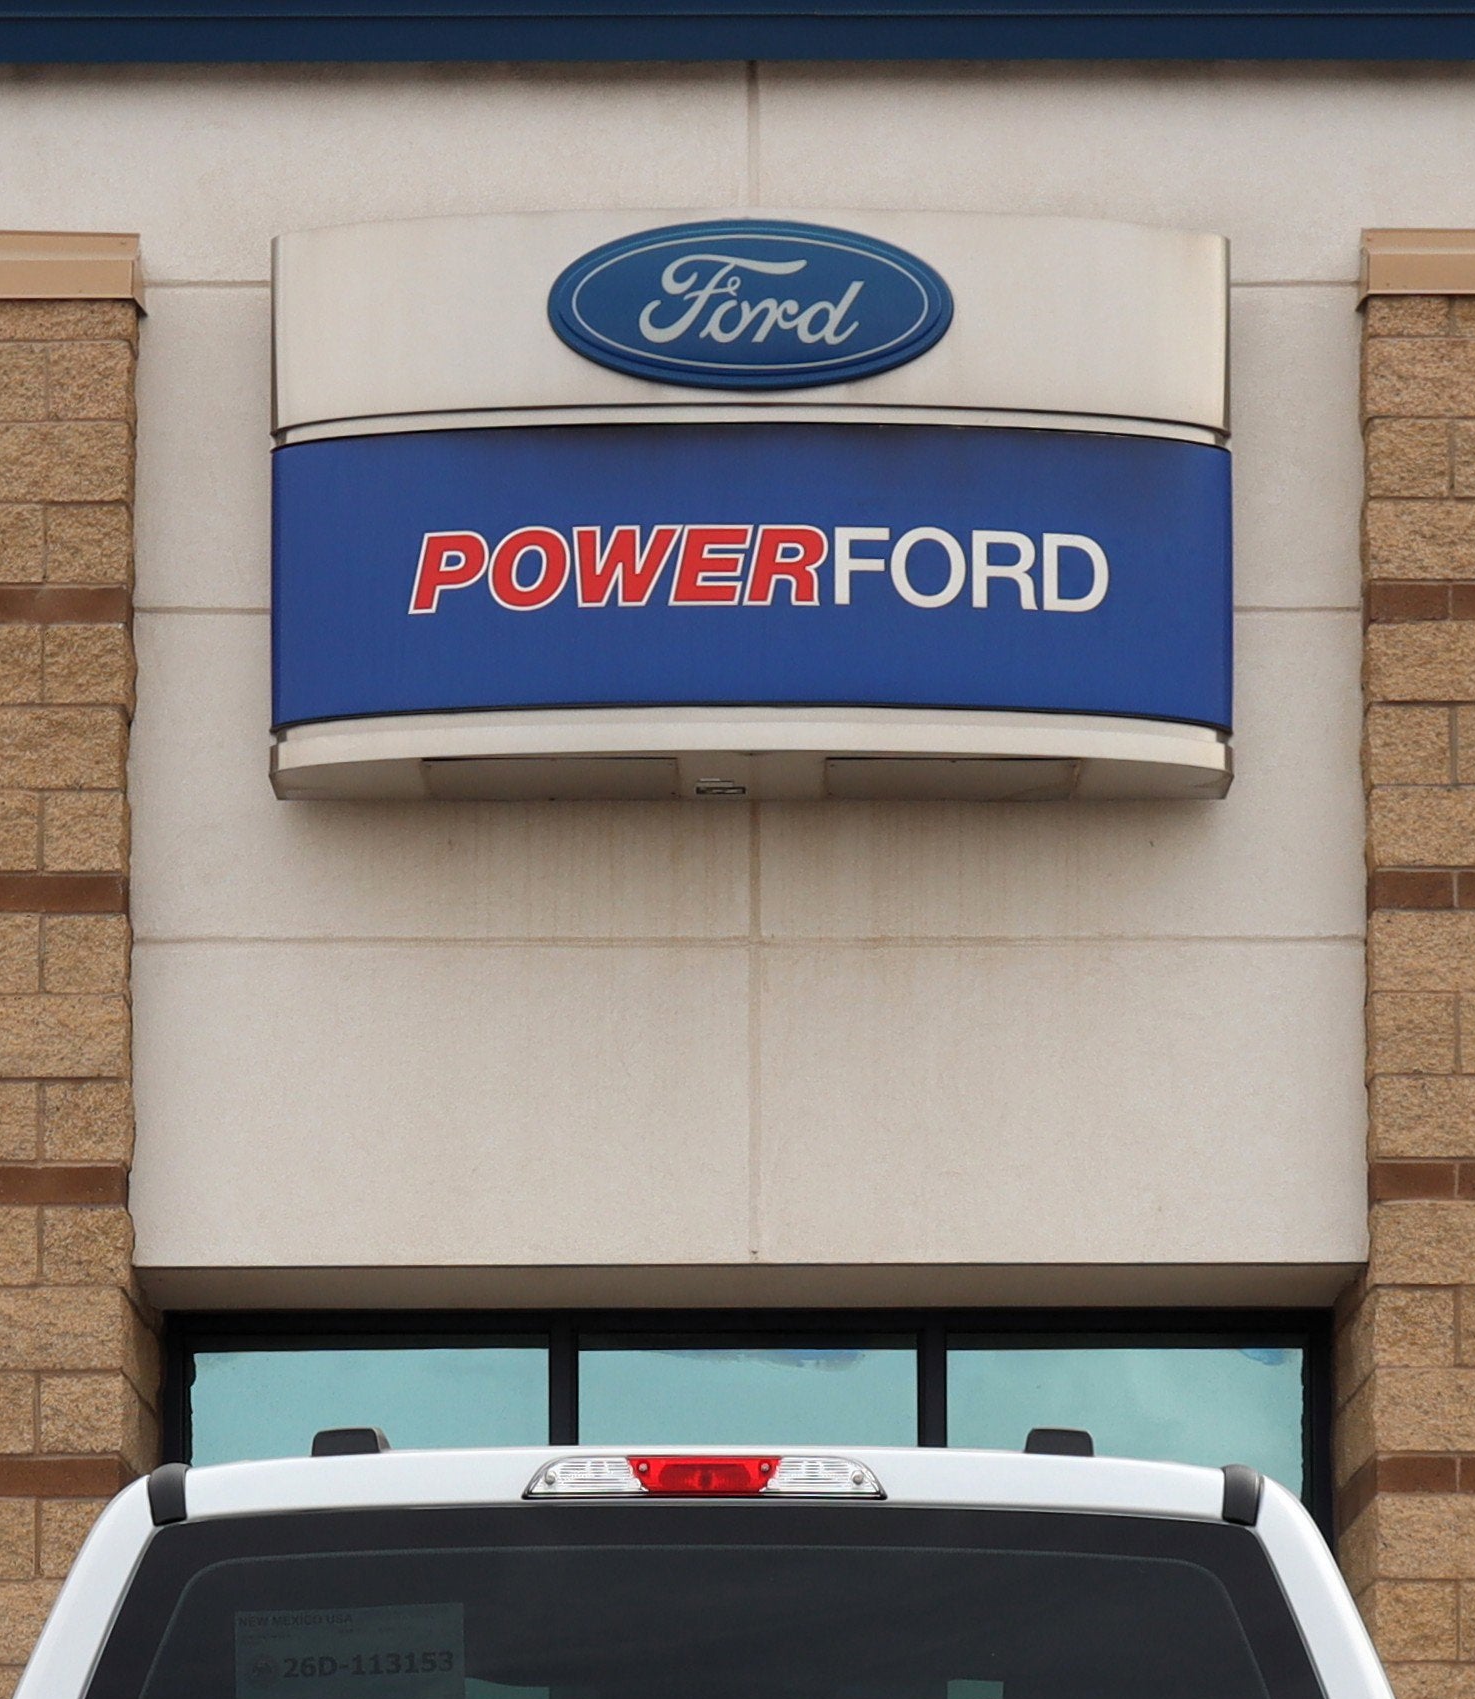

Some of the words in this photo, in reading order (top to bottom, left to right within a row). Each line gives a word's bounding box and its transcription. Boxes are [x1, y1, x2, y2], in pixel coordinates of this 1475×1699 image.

[638, 252, 863, 346] Ford
[408, 523, 1110, 615] POWERFORD
[283, 1651, 454, 1678] 26D-113153
